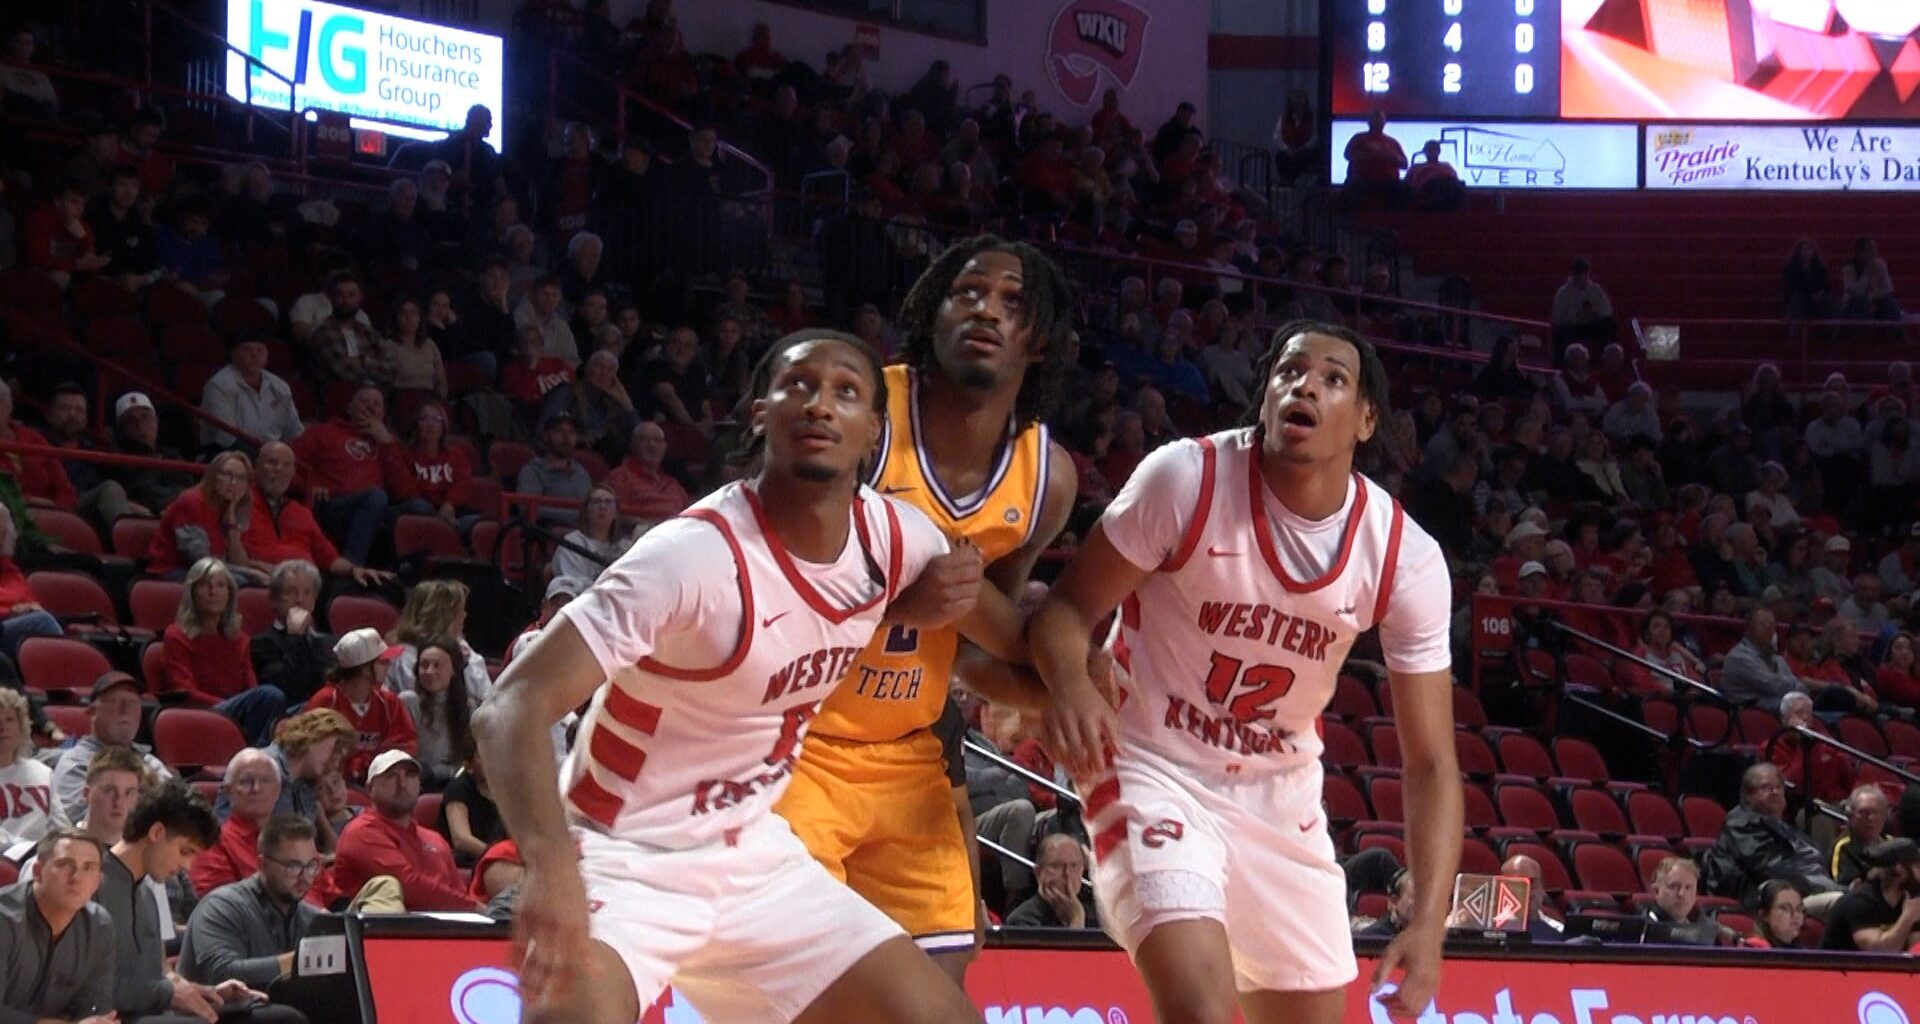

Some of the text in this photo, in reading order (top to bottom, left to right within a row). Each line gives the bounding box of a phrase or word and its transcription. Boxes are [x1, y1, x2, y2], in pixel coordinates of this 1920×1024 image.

[379, 24, 482, 64] Houchens
[1075, 12, 1128, 54] WKU
[1367, 21, 1534, 52] 8 4 0
[379, 51, 480, 90] Insurance
[1363, 62, 1534, 93] 12 2 0
[378, 77, 442, 113] Group
[1654, 140, 1740, 172] Prairie
[1802, 128, 1892, 152] We Are
[1470, 169, 1565, 185] VERS
[1668, 164, 1726, 185] Farms
[1745, 157, 1870, 187] Kentucky's
[1198, 601, 1337, 661] WESTERN
[1481, 616, 1510, 635] 106
[761, 647, 864, 706] WESTE
[856, 665, 924, 700] TECH
[1205, 650, 1296, 724] 12
